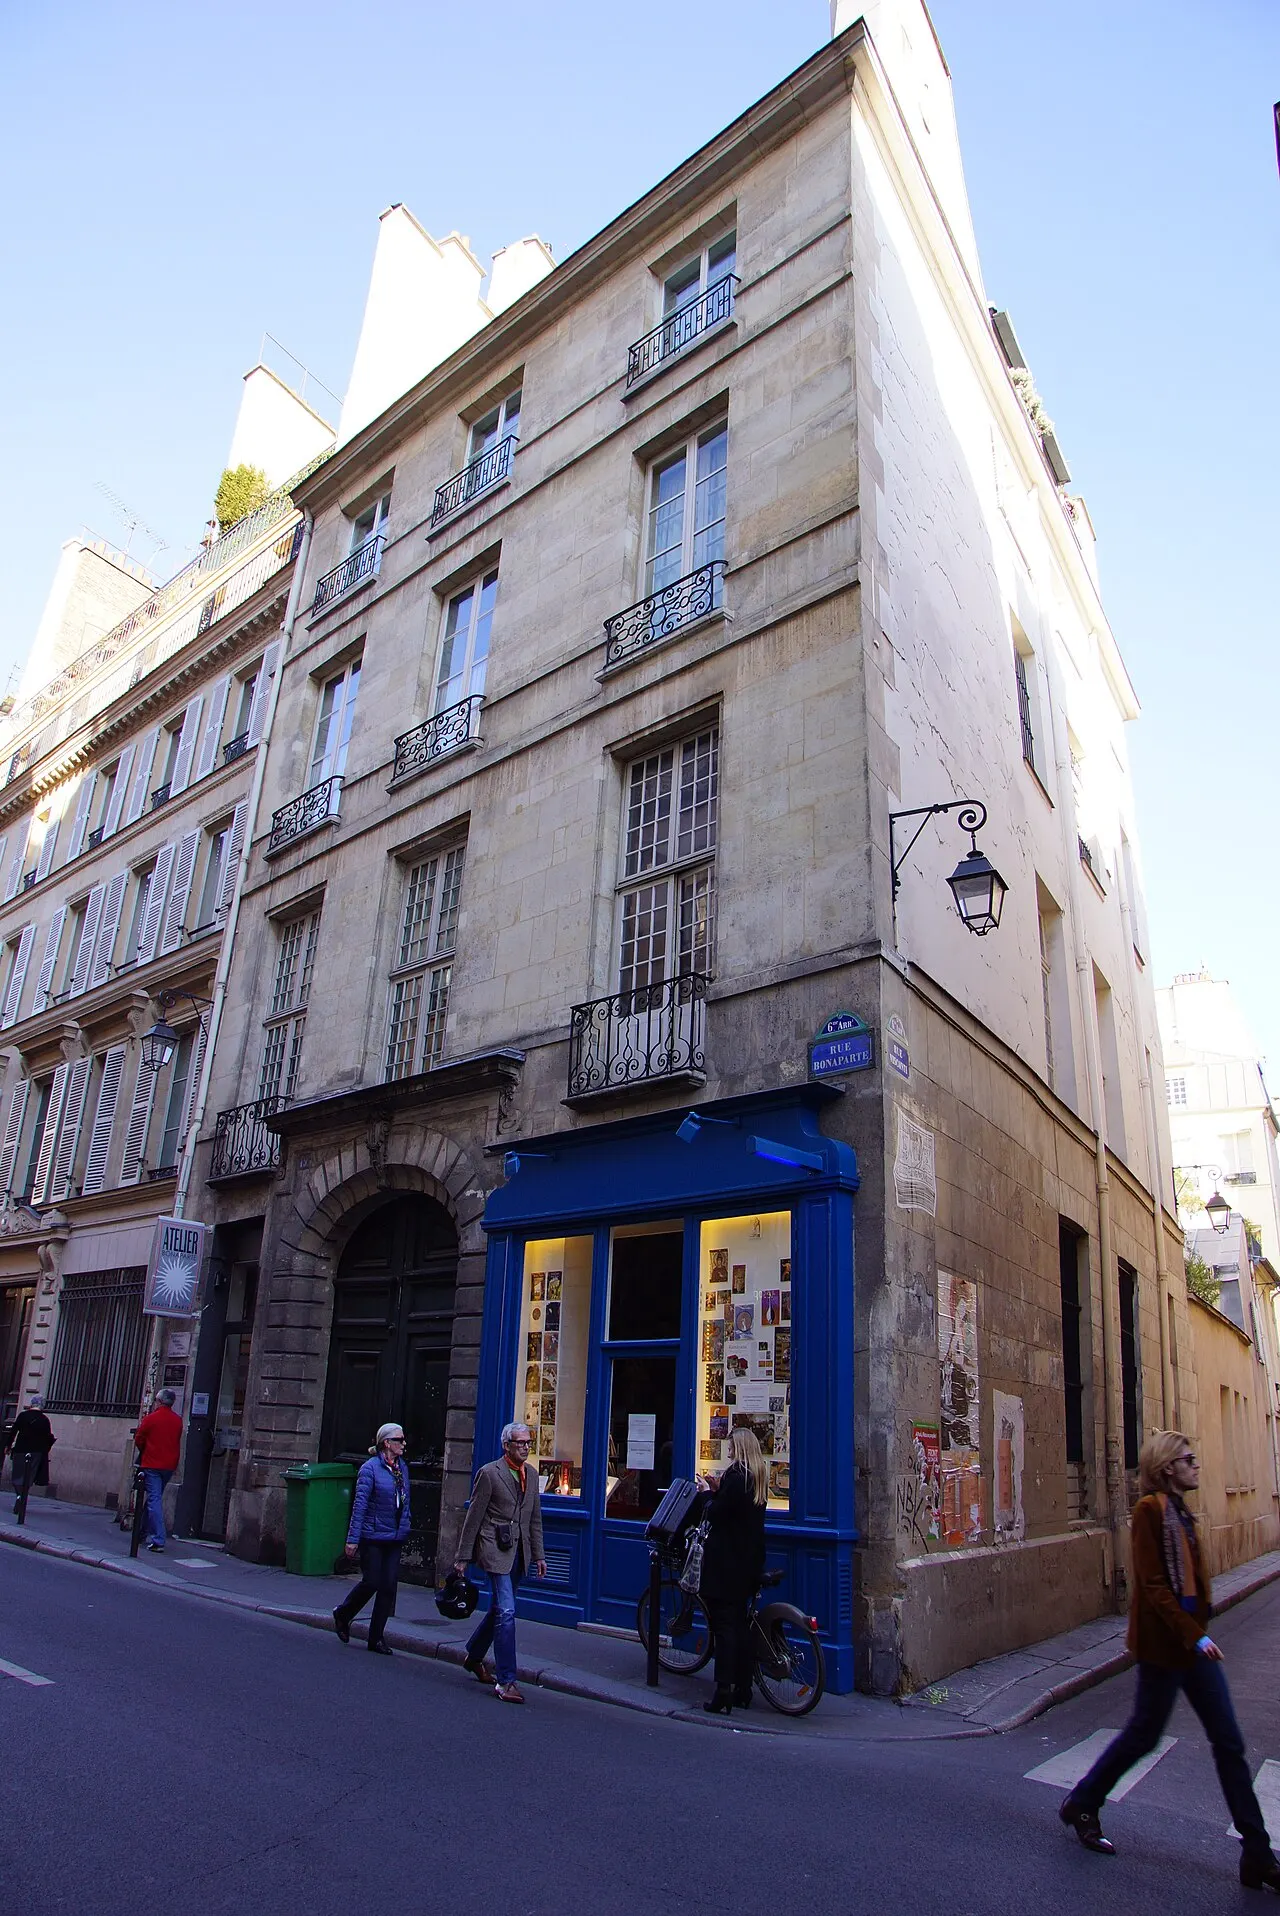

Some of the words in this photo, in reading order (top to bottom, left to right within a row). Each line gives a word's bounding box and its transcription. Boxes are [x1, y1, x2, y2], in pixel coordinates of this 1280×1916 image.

[830, 1042, 851, 1055] RUE
[893, 1044, 903, 1059] RUE
[813, 1050, 869, 1071] BONAPARTE
[162, 1226, 199, 1255] ATELIER
[161, 1249, 197, 1262] BONAPARTE
